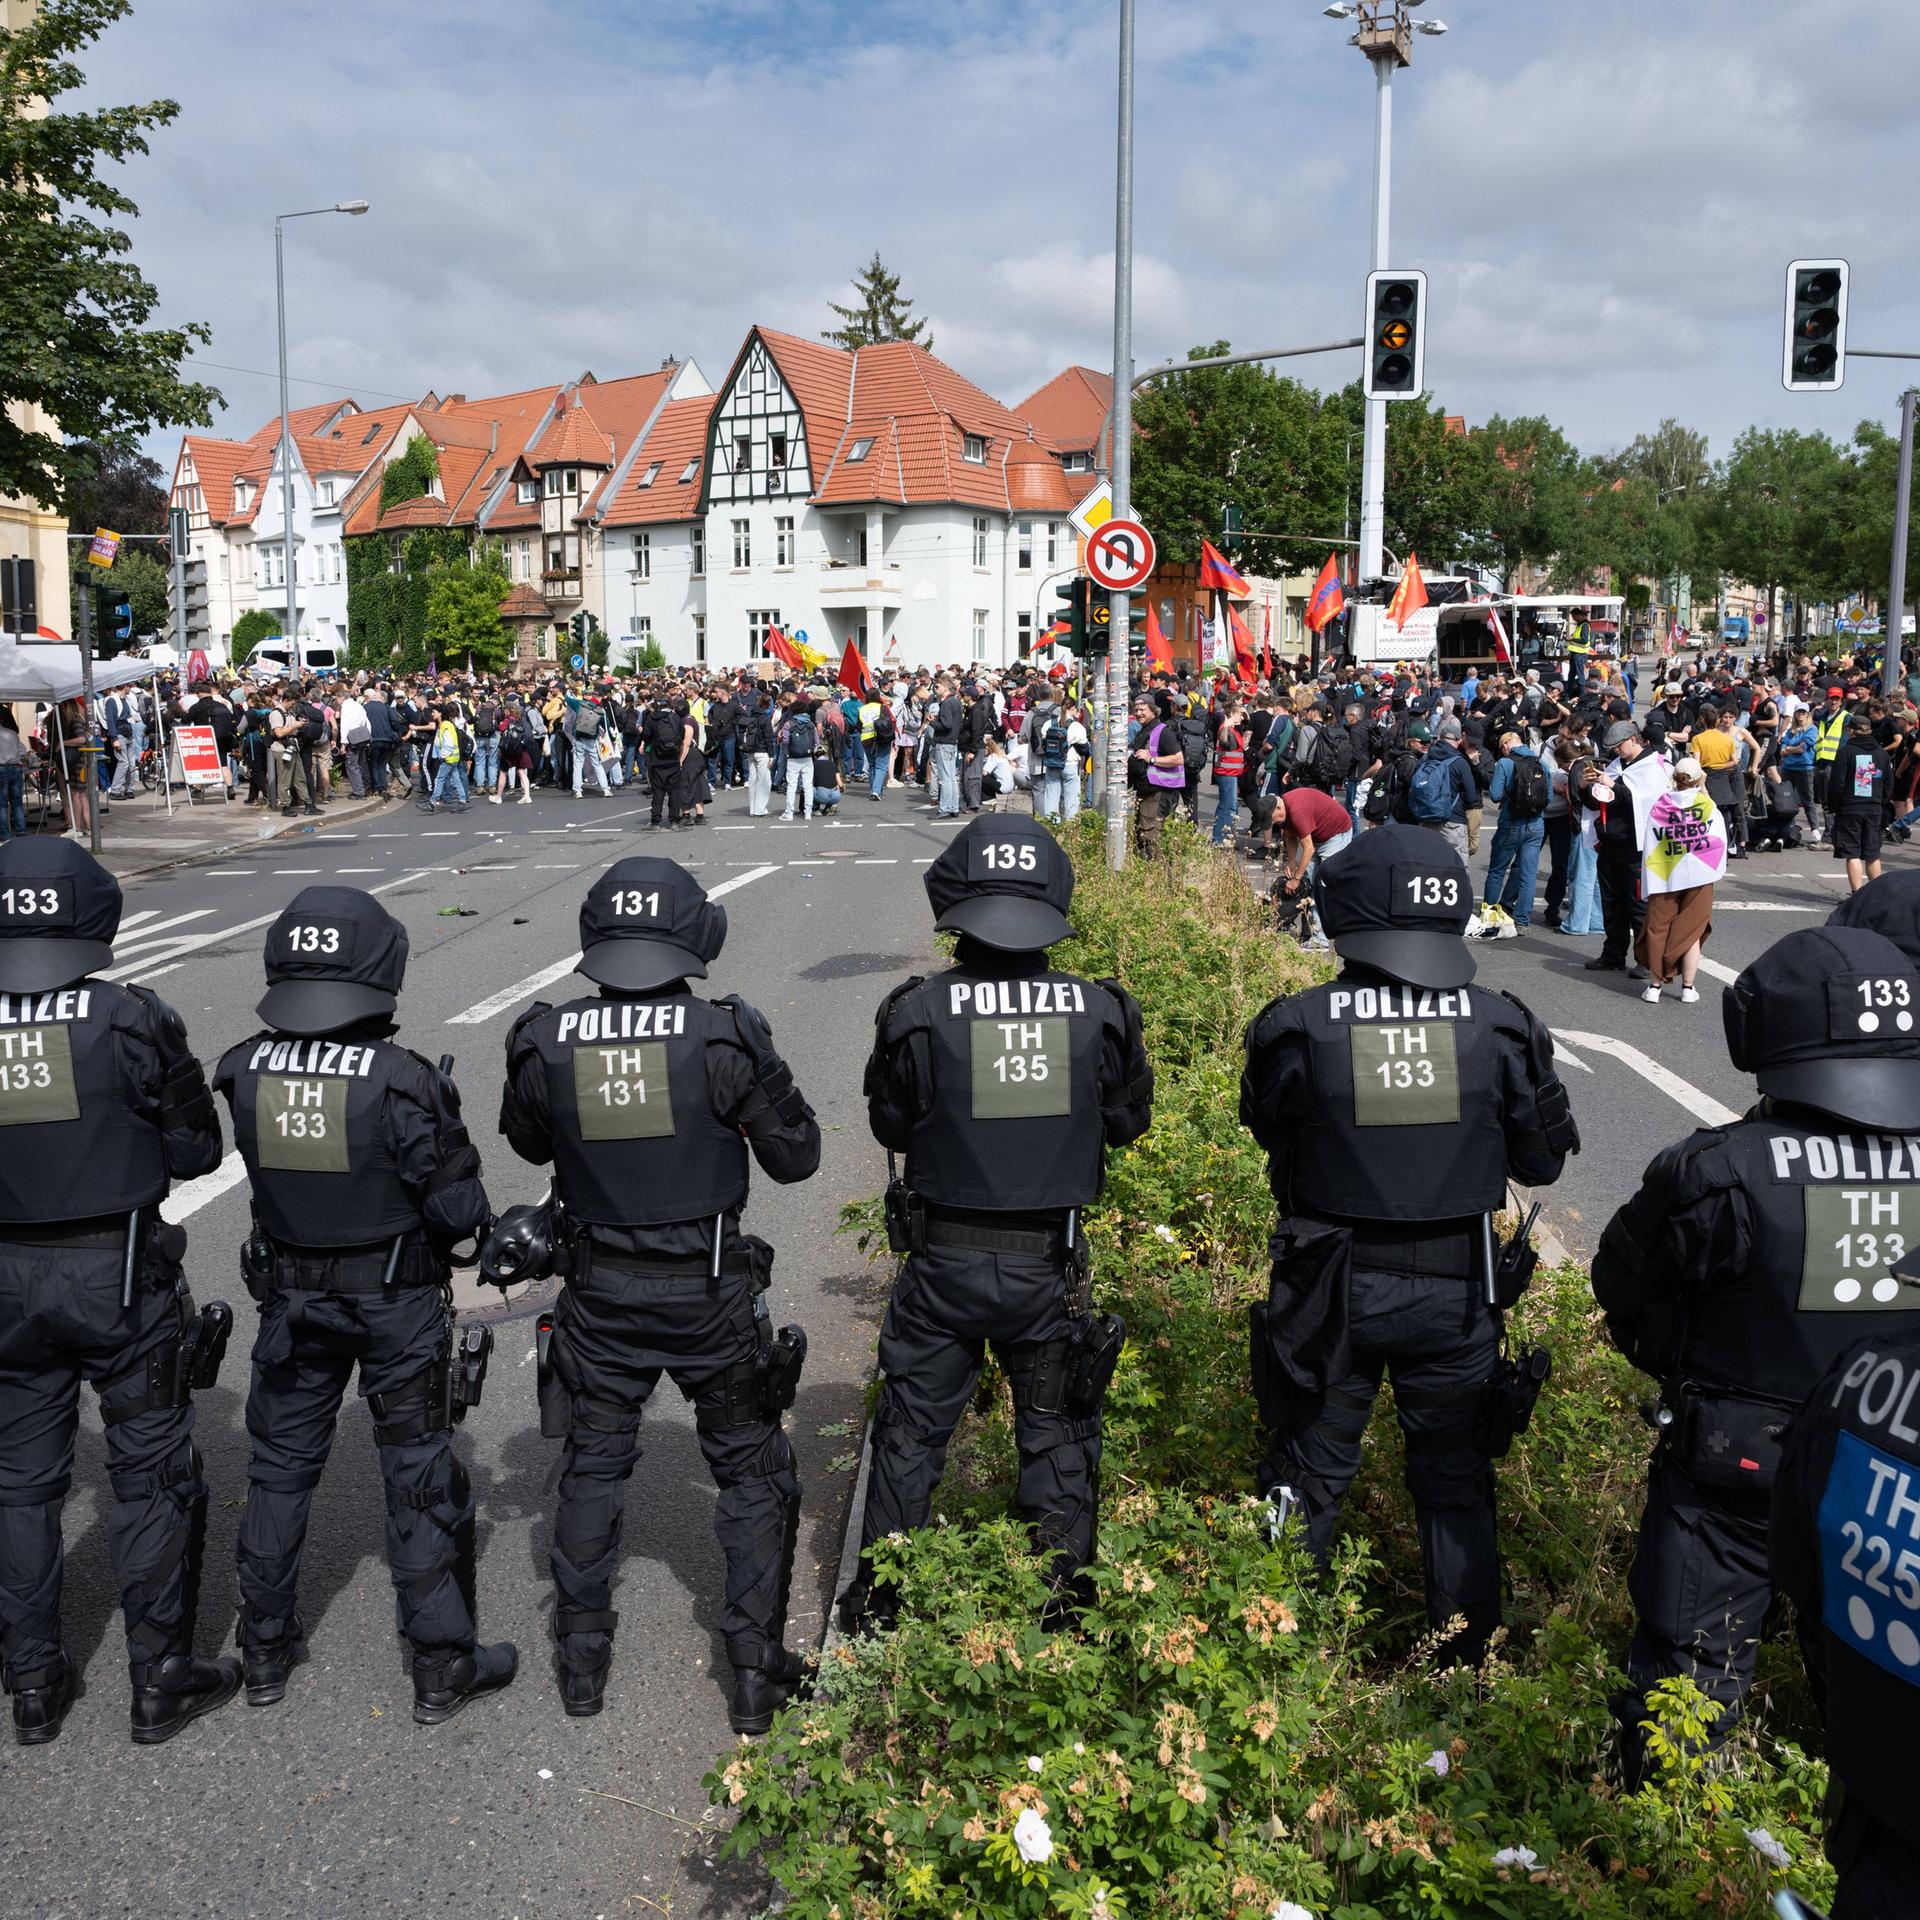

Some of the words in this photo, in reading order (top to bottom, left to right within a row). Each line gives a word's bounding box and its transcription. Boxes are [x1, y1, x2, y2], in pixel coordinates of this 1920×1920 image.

[180, 736, 214, 747] Socialism
[181, 746, 200, 758] great
[1668, 808, 1704, 824] AFD
[982, 844, 1036, 871] 135
[1, 888, 59, 915] 133
[611, 890, 659, 917] 131
[1407, 876, 1458, 906] 133
[288, 926, 340, 953] 133
[950, 981, 1085, 1015] POLIZEI
[1329, 986, 1472, 1020] POLIZEI
[1858, 979, 1911, 1007] 133
[557, 1005, 686, 1042] POLIZEI
[997, 1022, 1043, 1050] TH
[0, 1031, 44, 1059] TH
[1380, 1027, 1428, 1055] TH
[249, 1040, 375, 1077] POLIZEI
[599, 1048, 642, 1076] TH
[993, 1055, 1049, 1083] 135
[0, 1061, 52, 1091] 133
[1376, 1059, 1435, 1089] 133
[283, 1080, 324, 1108] TH
[598, 1079, 647, 1107] 131
[275, 1111, 327, 1139] 133
[1841, 1191, 1900, 1226] TH
[1834, 1233, 1906, 1268] 133
[1864, 1457, 1920, 1541] TH
[1841, 1520, 1920, 1611] 225
